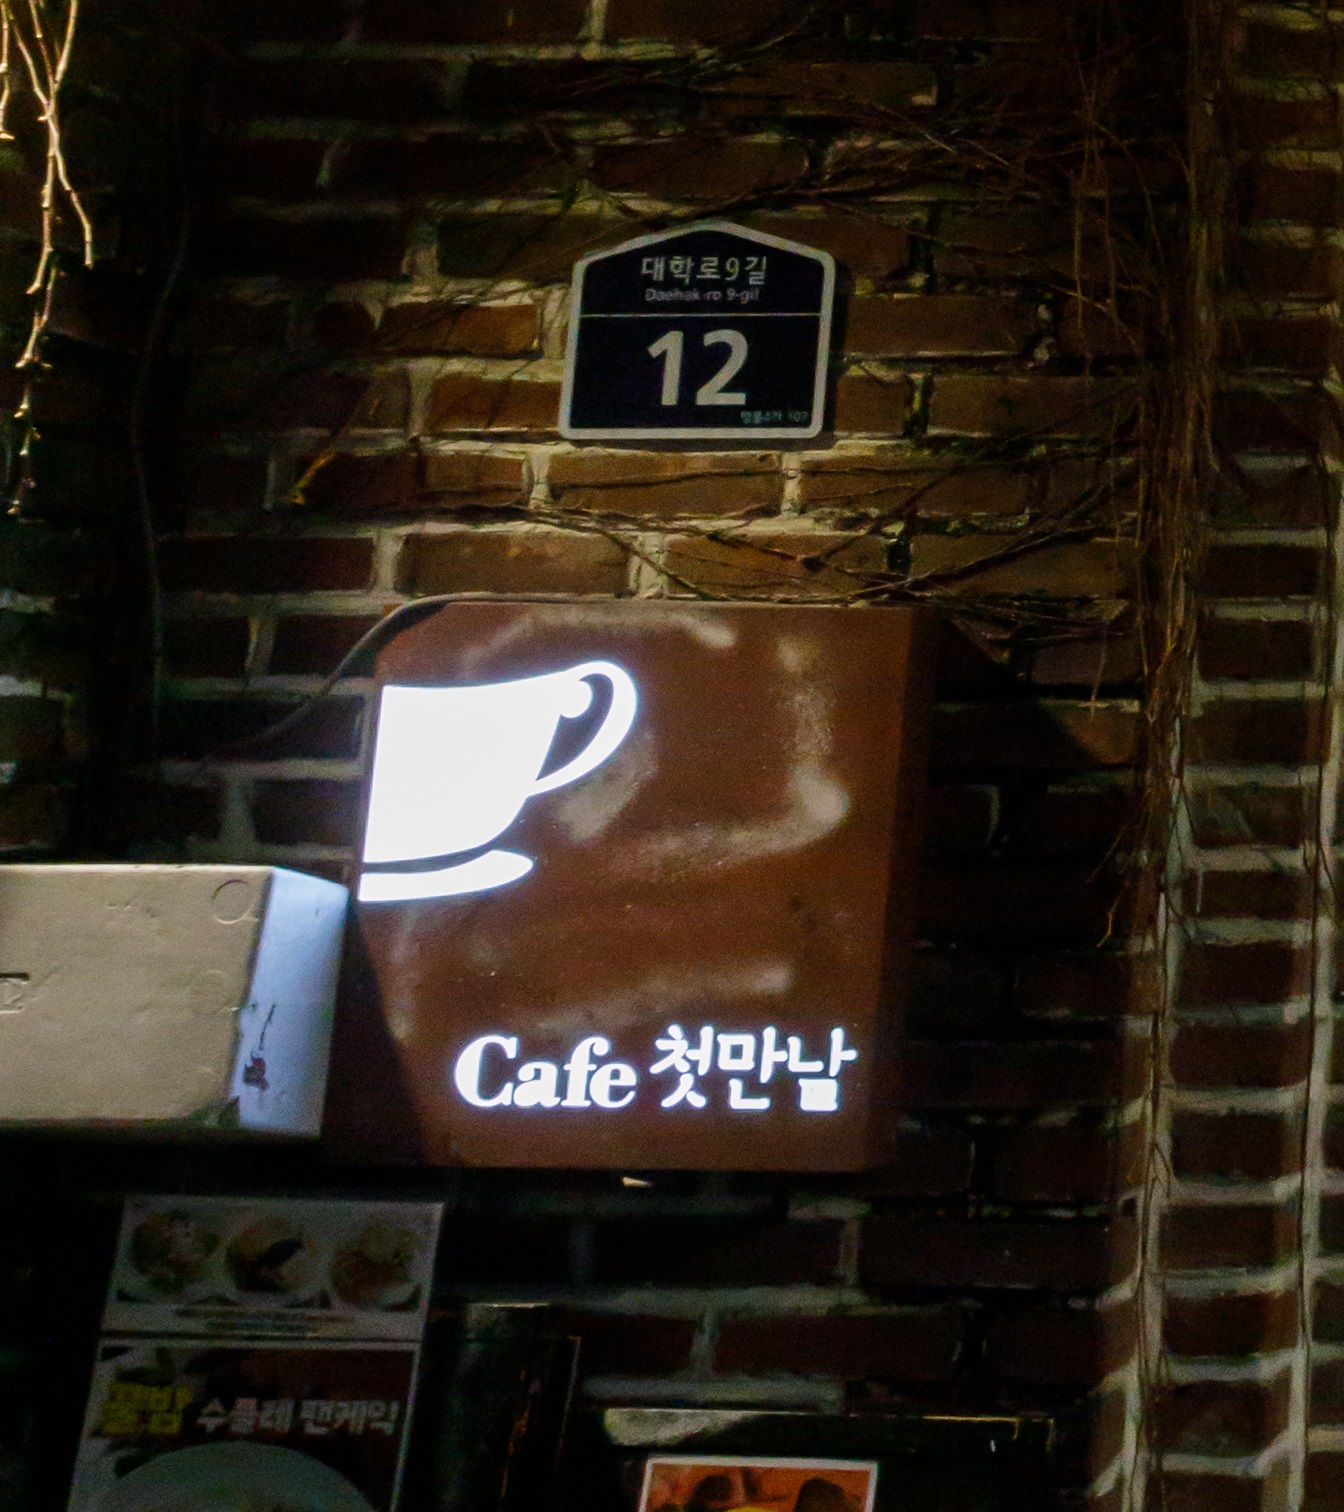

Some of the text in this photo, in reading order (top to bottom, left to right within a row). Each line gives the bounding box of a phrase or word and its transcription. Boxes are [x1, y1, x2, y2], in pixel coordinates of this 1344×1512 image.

[641, 255, 768, 286] 대학로9길
[647, 328, 749, 406] 12
[453, 1033, 638, 1109] Cafe
